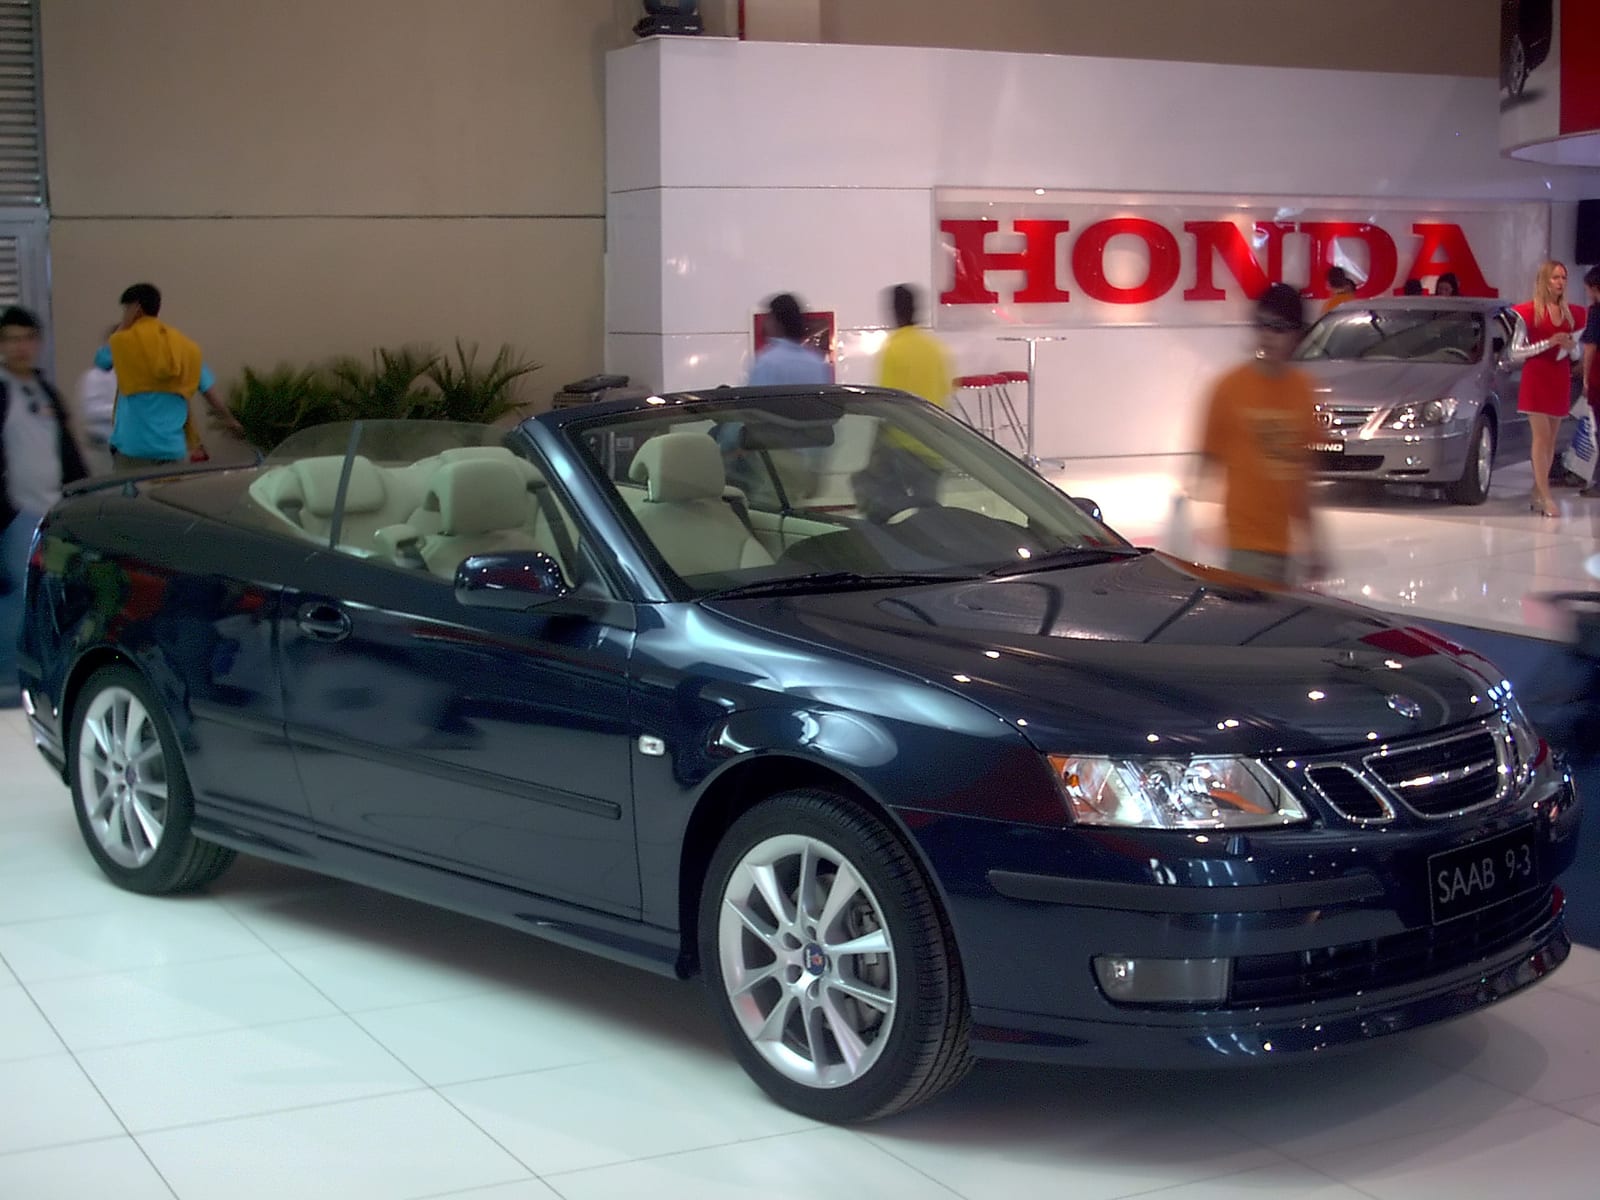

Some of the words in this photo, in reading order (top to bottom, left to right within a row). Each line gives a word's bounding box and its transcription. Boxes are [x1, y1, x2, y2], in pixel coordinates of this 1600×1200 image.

[940, 217, 1499, 304] HONDA
[1437, 857, 1496, 904] SAAB
[1505, 844, 1532, 879] 9-3
